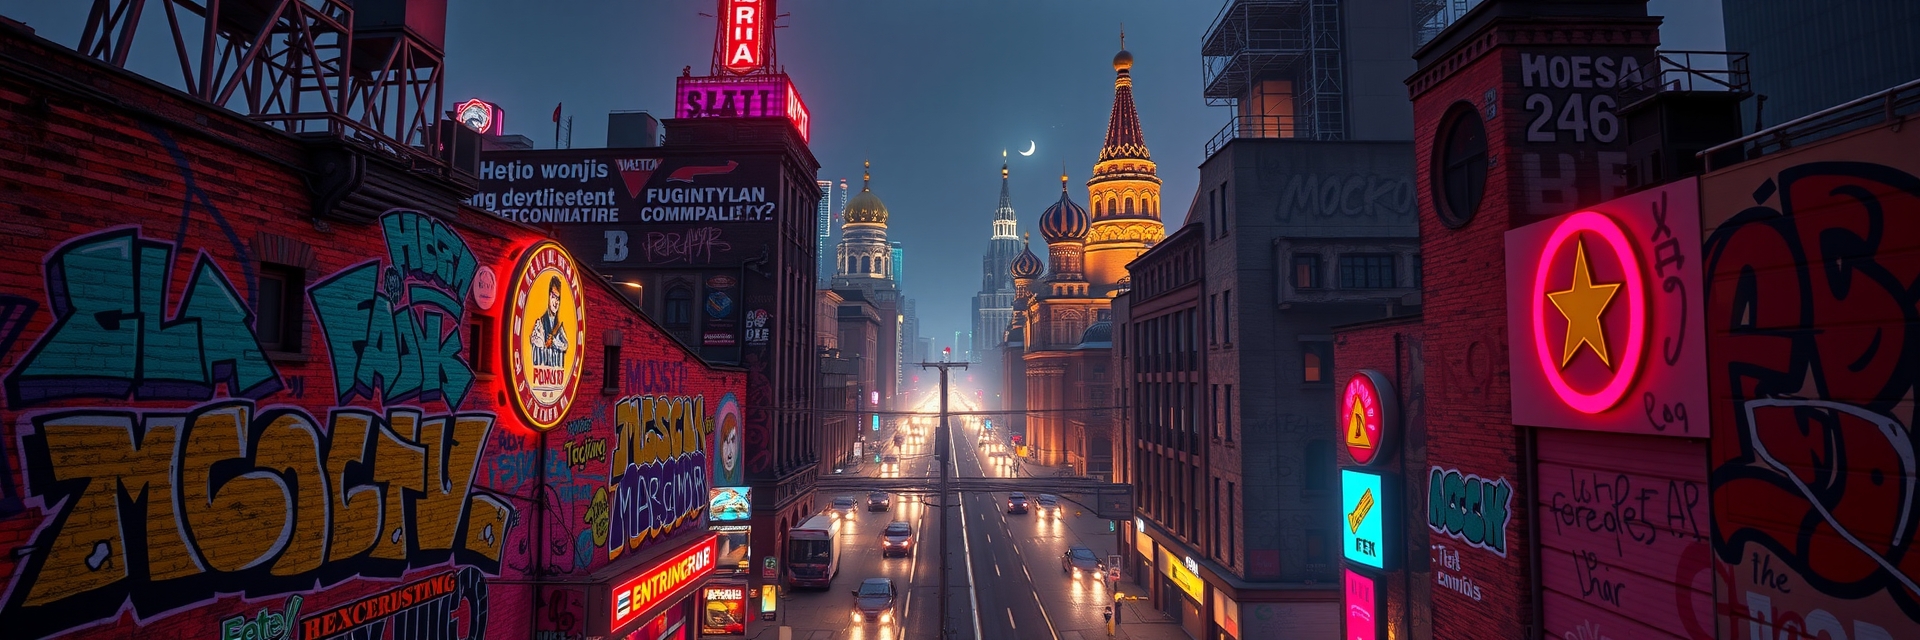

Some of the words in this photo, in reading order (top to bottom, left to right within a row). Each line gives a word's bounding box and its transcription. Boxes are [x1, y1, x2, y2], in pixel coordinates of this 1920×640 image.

[1525, 93, 1619, 144] 246
[541, 159, 608, 183] wonjis
[603, 230, 629, 262] B
[1752, 552, 1791, 593] the
